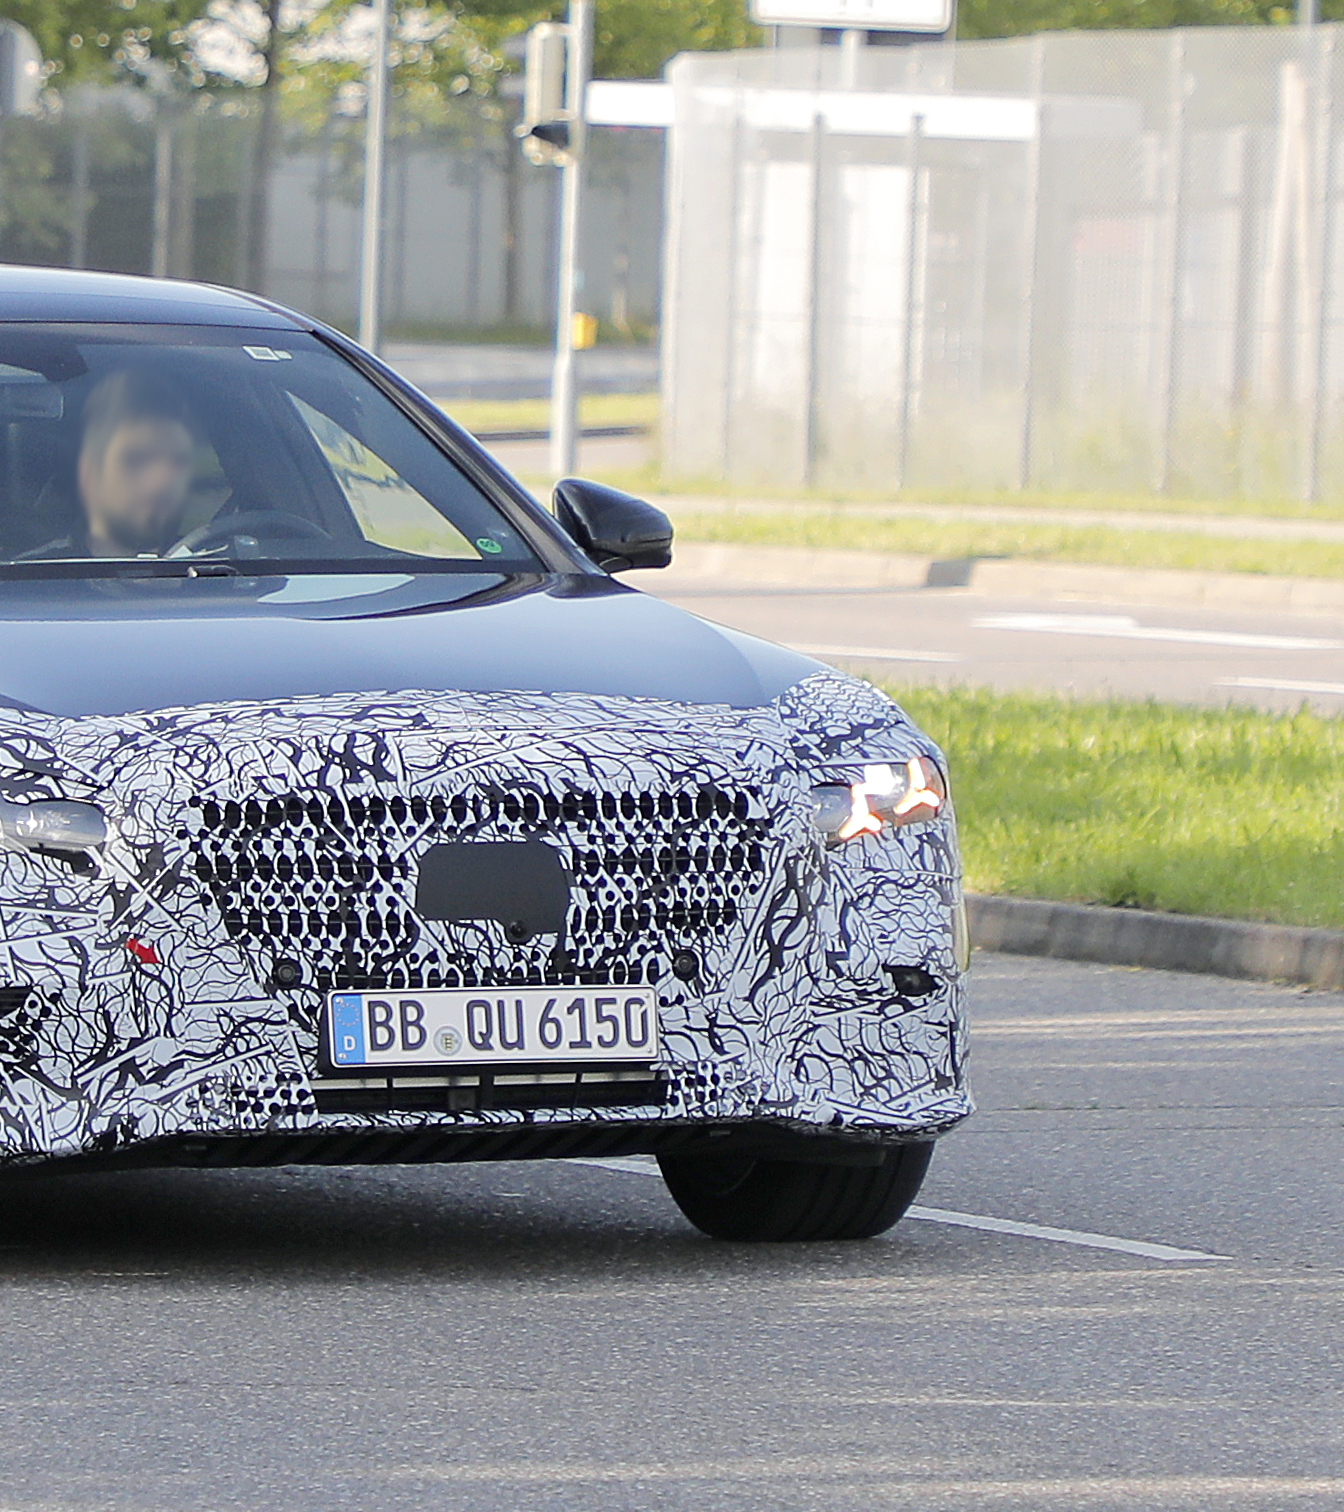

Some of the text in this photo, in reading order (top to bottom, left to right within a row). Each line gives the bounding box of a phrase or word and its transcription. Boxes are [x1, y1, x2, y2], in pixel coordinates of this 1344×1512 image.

[367, 997, 649, 1051] BB QU 6150
[343, 1035, 356, 1051] D
